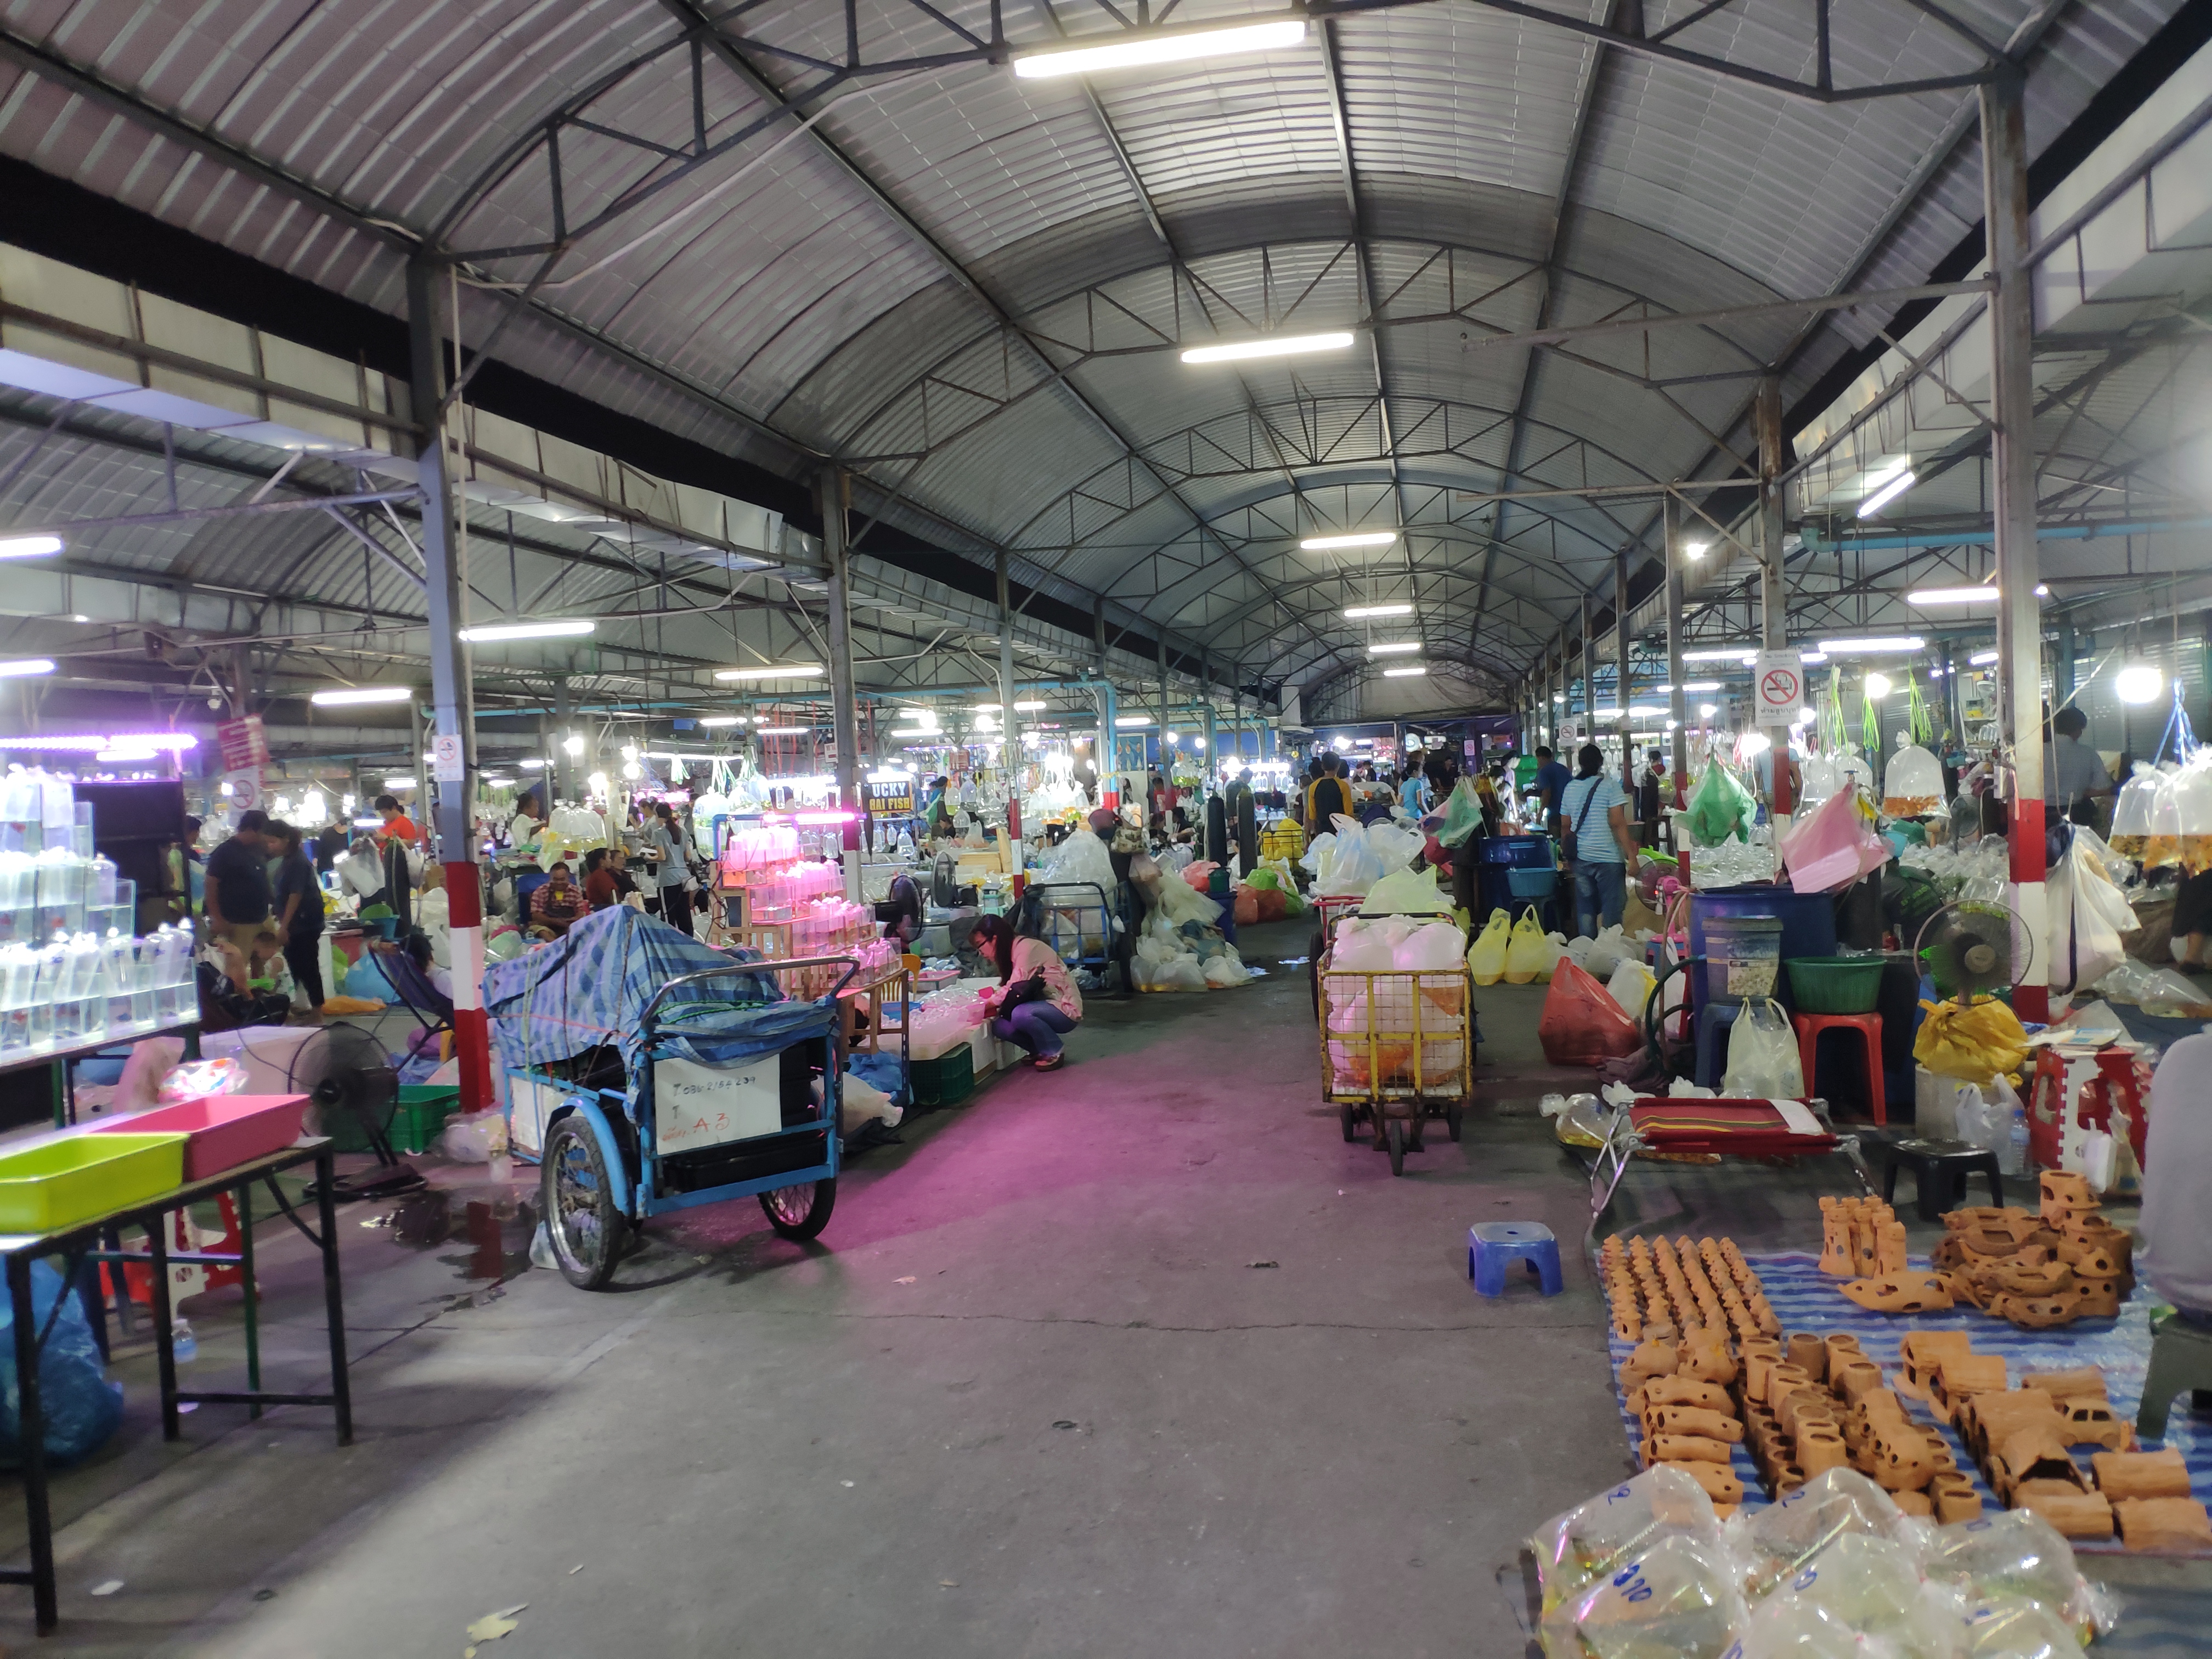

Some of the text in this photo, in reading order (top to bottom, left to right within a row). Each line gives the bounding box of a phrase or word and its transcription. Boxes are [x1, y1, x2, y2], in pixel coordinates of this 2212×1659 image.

[864, 782, 906, 798] UCKY
[869, 797, 911, 811] HAI FISH
